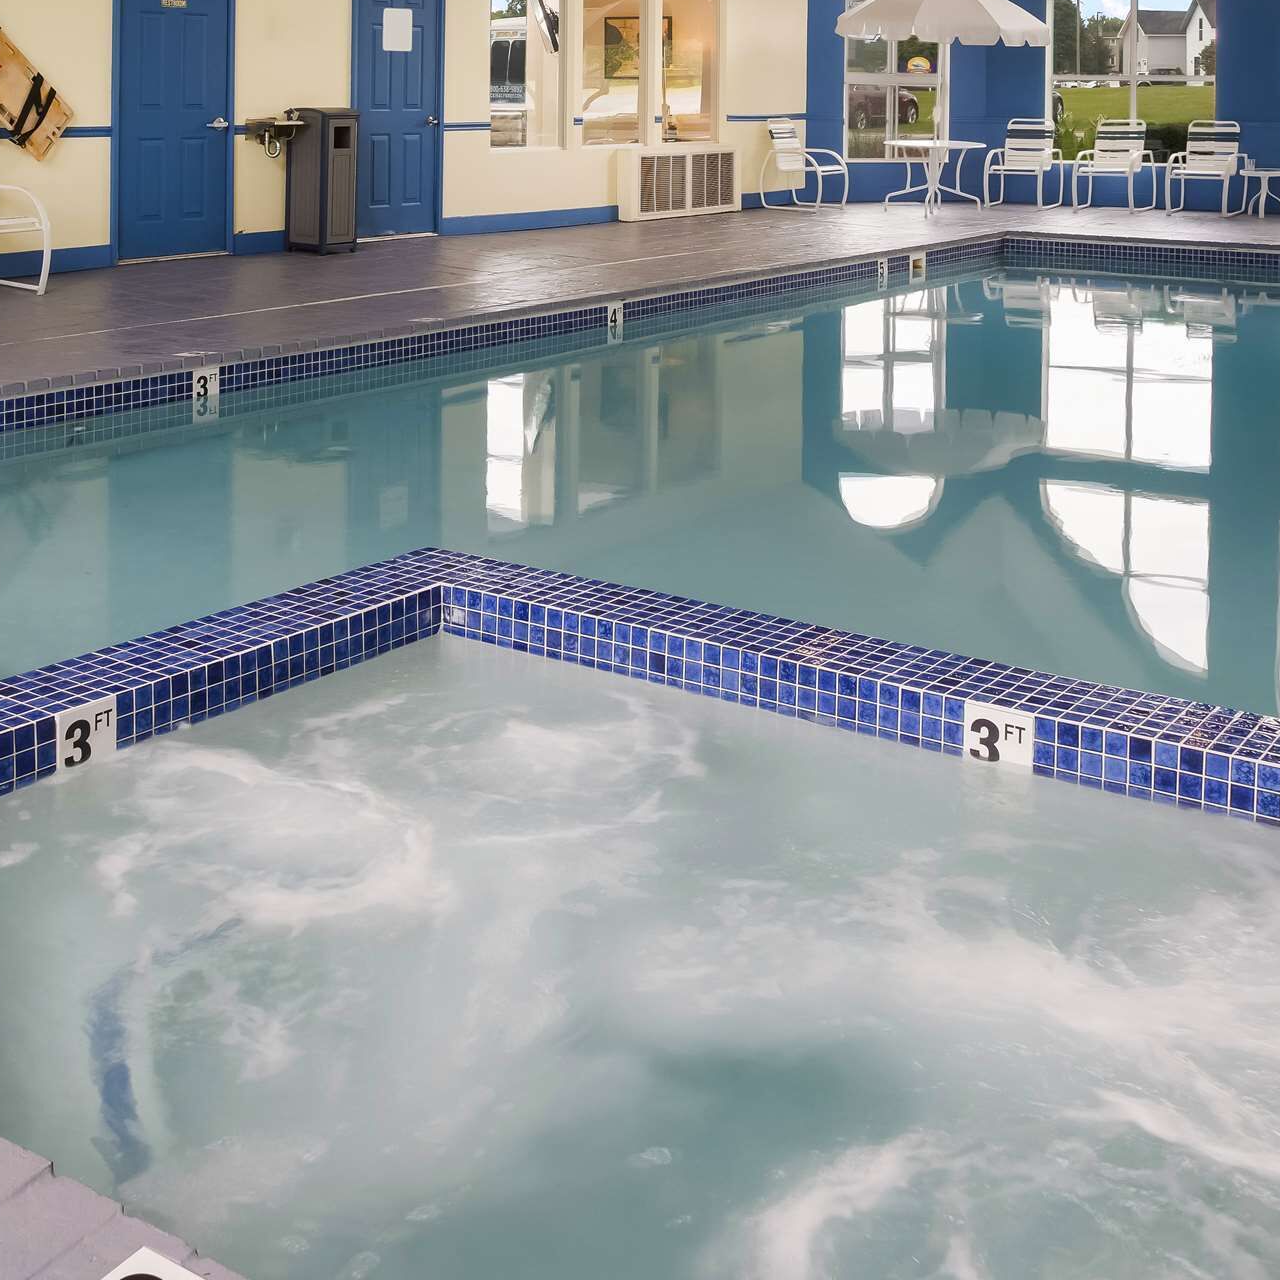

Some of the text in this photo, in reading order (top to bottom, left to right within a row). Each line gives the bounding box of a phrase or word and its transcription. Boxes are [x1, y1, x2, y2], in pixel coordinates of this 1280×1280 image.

[610, 308, 617, 324] 4
[196, 375, 208, 397] 3
[64, 708, 113, 768] 3 FT
[969, 718, 1026, 762] 3 FT
